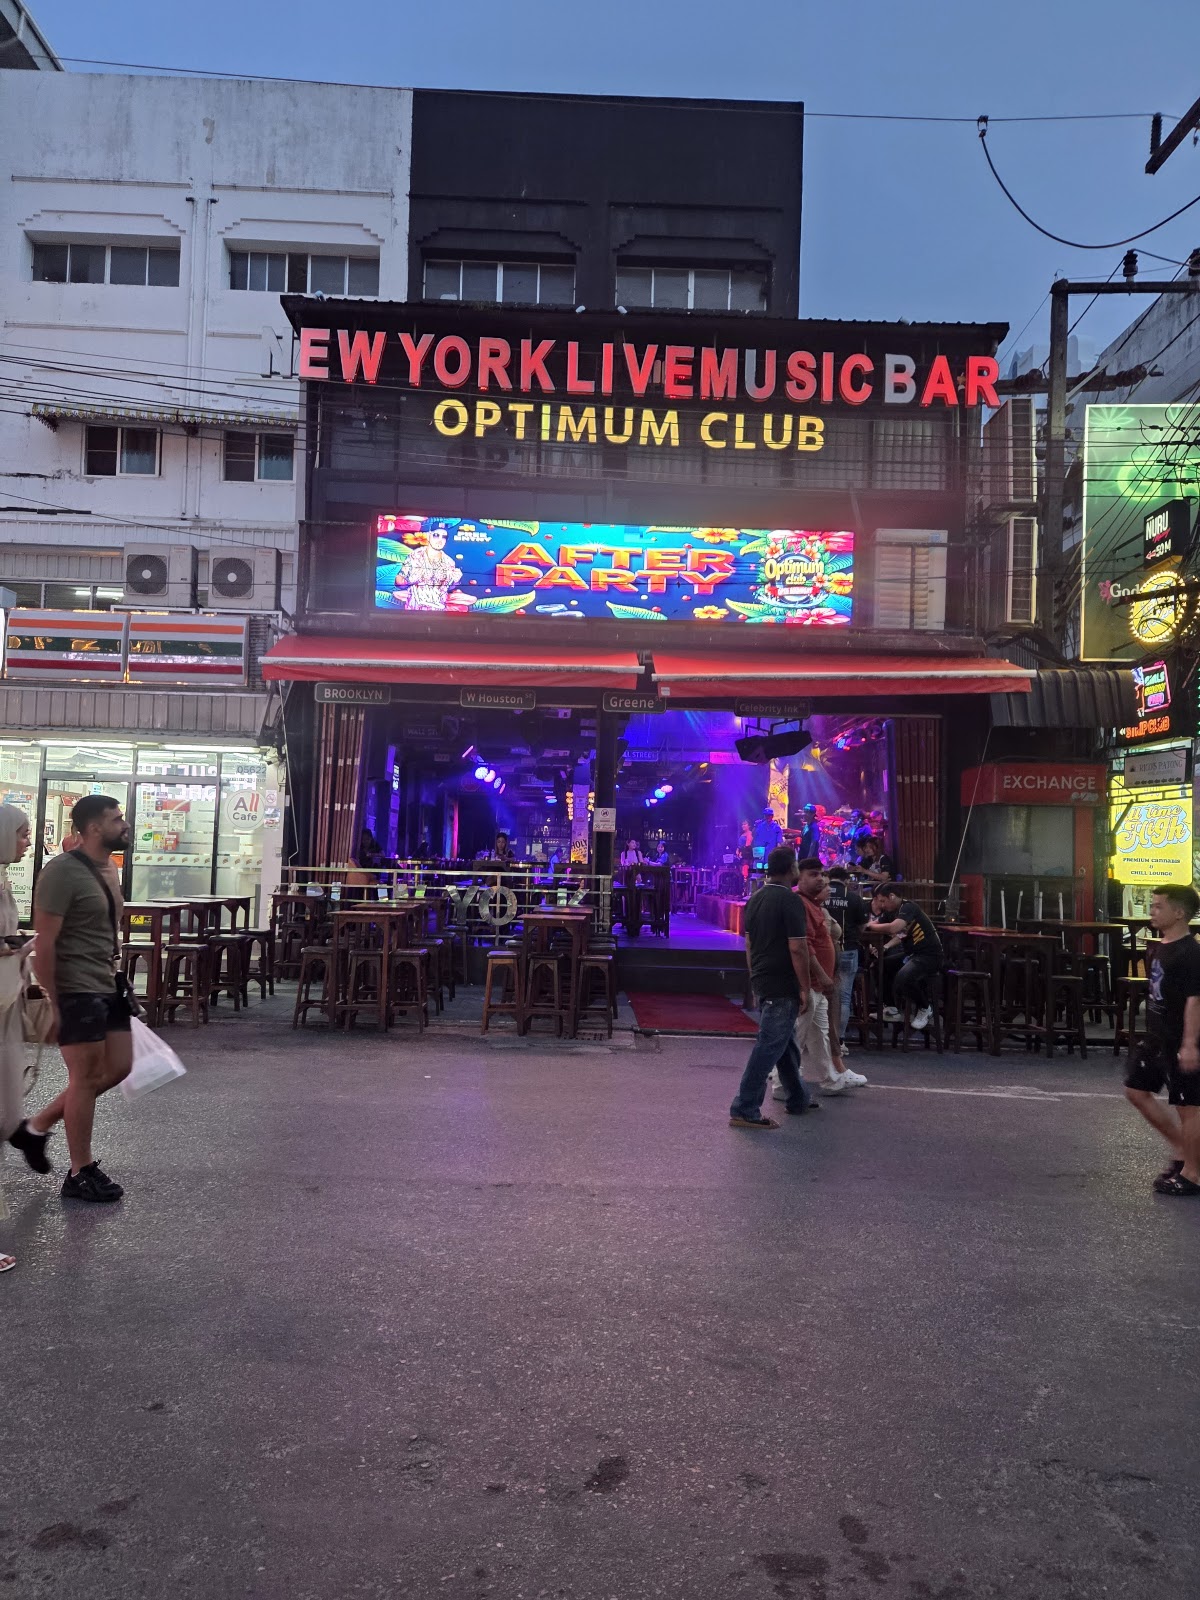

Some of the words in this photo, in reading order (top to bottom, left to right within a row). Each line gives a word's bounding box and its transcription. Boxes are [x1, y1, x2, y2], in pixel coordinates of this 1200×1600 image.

[398, 332, 557, 392] YORK
[567, 341, 695, 398] LIVE
[701, 347, 875, 405] MUSIC
[884, 353, 1001, 408] BAR
[434, 399, 680, 447] OPTIMUM
[700, 411, 825, 451] CLUB
[1145, 510, 1169, 541] NURU
[500, 541, 736, 574] AFTER
[764, 558, 825, 581] Optimum
[495, 563, 734, 596] PARTY
[323, 688, 383, 700] BROOKLYN
[466, 693, 476, 702] W
[478, 693, 523, 705] Houston
[609, 696, 655, 709] Greene
[739, 703, 783, 715] Celebrity
[784, 704, 799, 714] Ink
[236, 765, 267, 774] 05622
[1002, 774, 1097, 790] EXCHANGE
[233, 792, 260, 813] All
[1145, 803, 1183, 820] time
[1116, 814, 1189, 851] High
[831, 898, 849, 908] YORK
